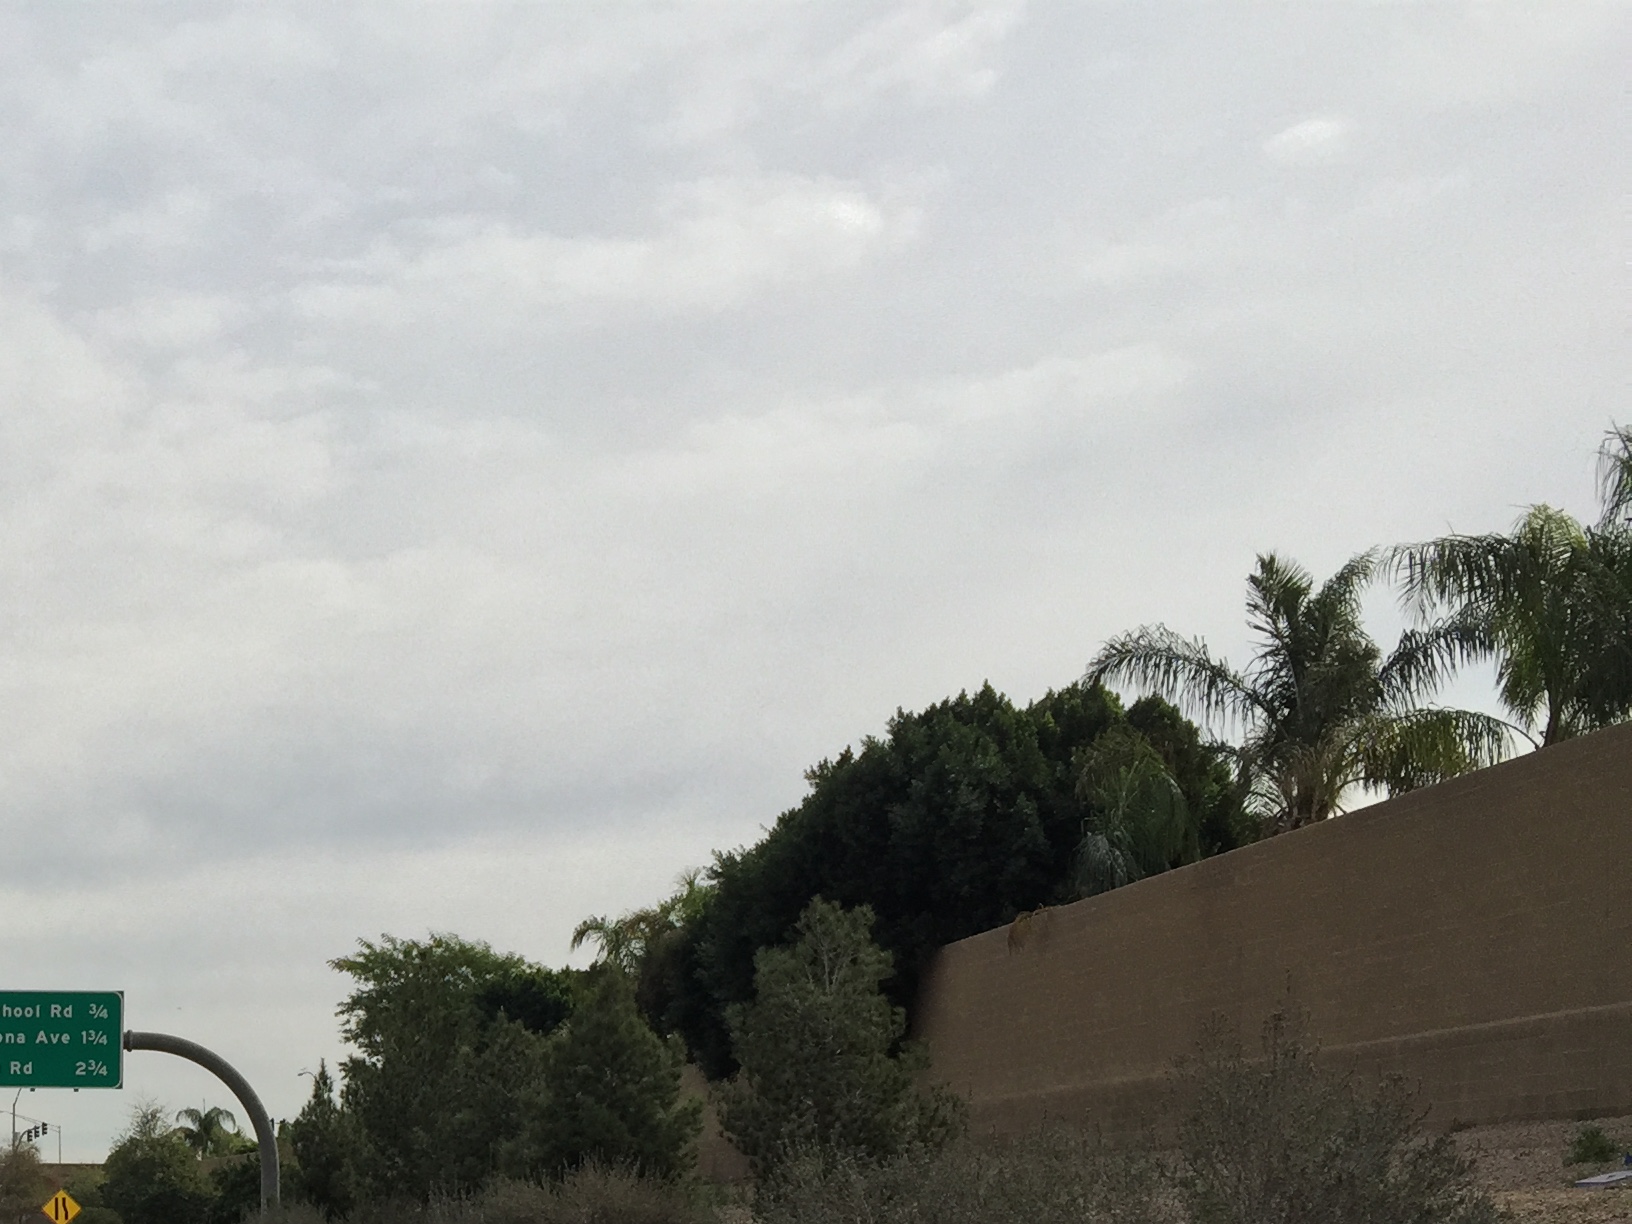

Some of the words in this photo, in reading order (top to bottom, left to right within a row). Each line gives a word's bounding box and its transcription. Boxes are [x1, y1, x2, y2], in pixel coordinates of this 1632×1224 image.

[50, 1004, 73, 1018] Rd
[36, 1030, 70, 1044] Ave
[10, 1061, 32, 1075] Rd
